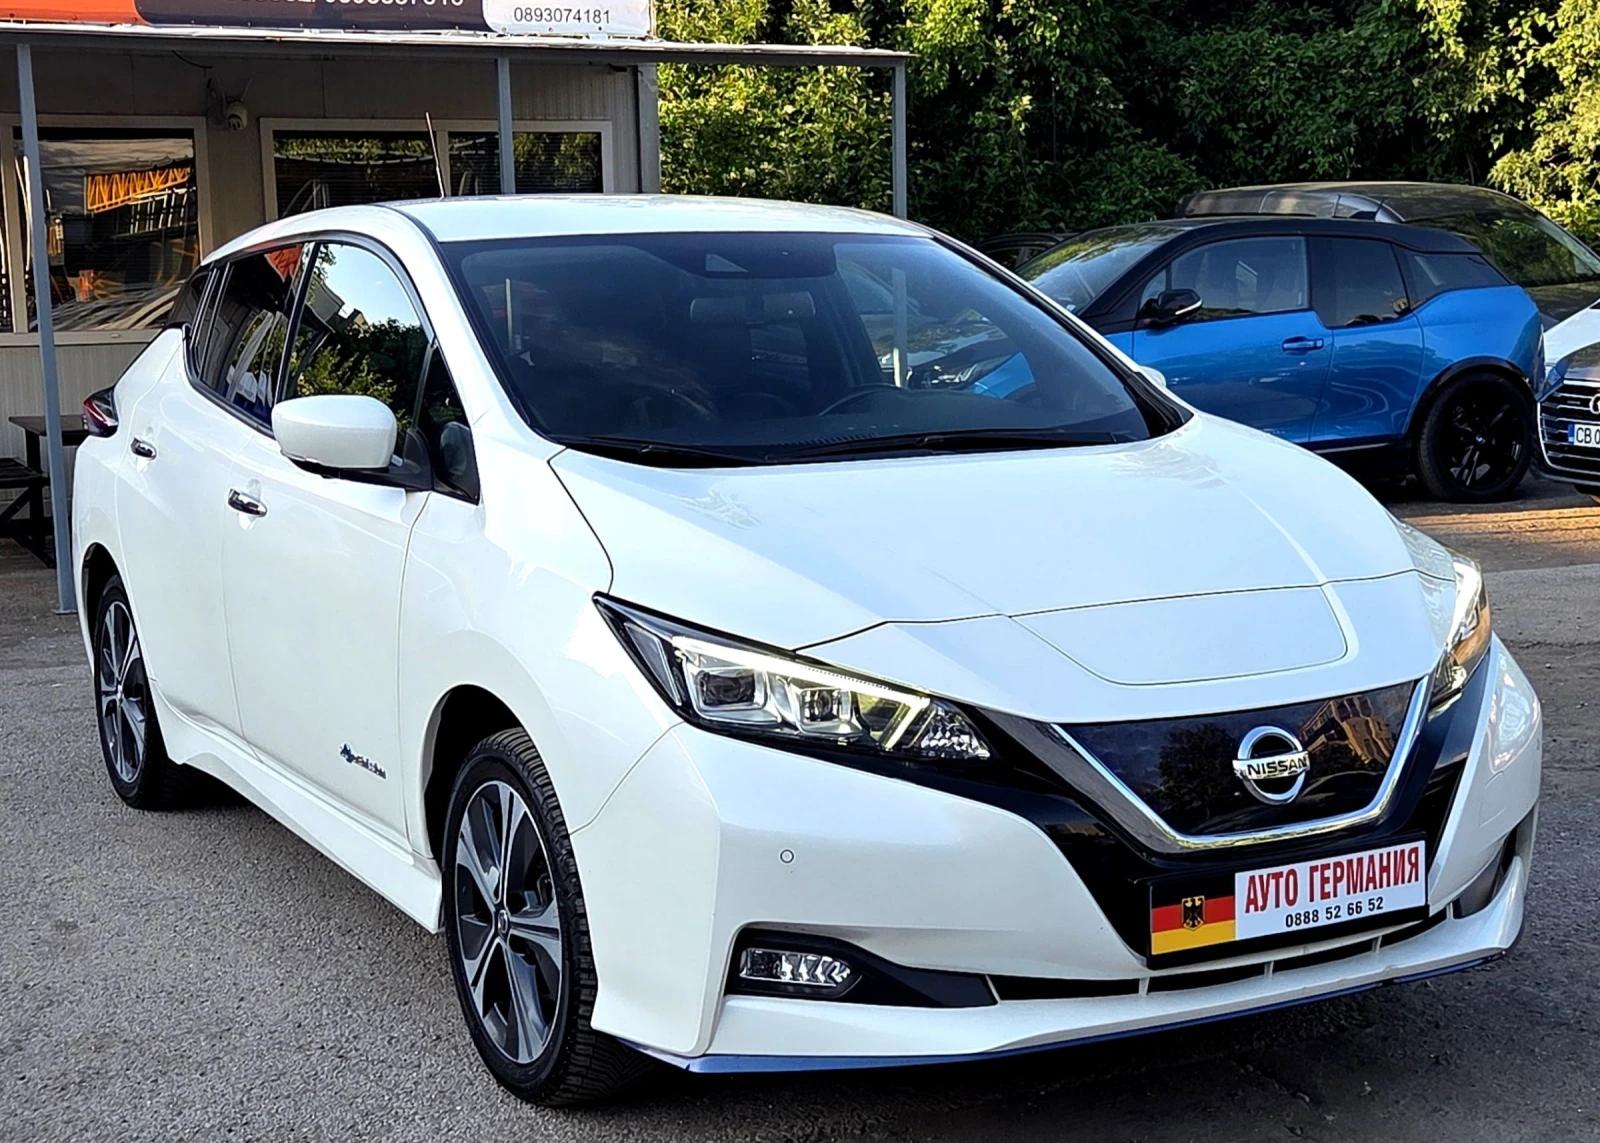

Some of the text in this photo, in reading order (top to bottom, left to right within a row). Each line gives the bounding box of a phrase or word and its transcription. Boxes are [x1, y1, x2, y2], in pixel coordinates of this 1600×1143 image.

[514, 7, 610, 24] 0893074181
[1246, 755, 1308, 777] NISSAN
[1245, 846, 1419, 914] АУТО ГЕРМАНИЯ
[1285, 896, 1384, 928] 0888 52 66 52
